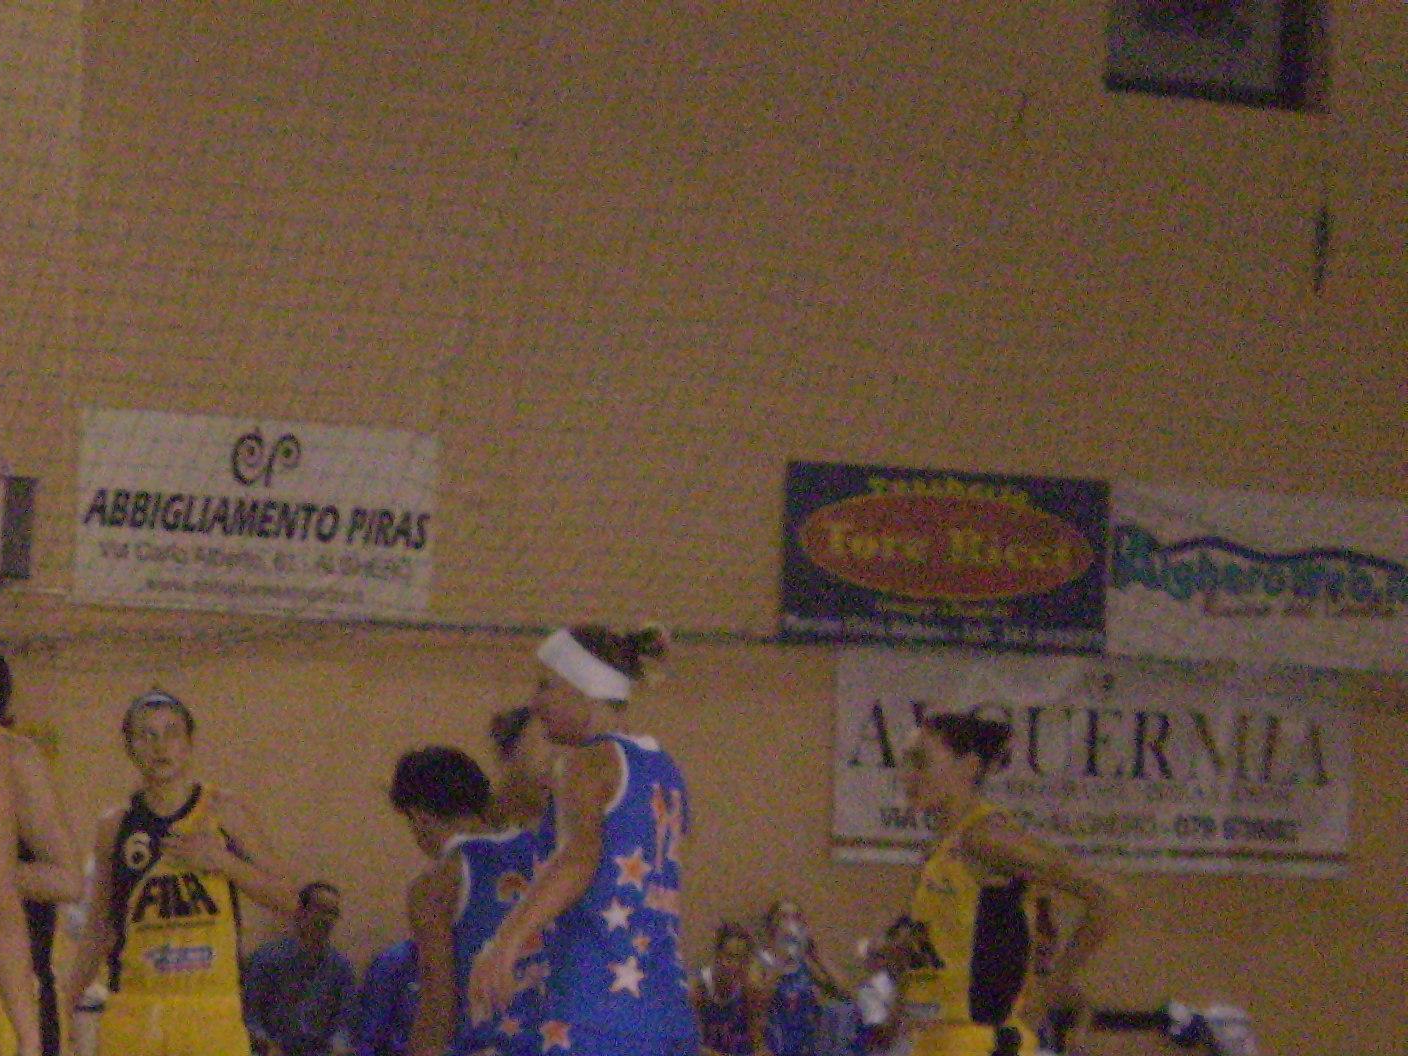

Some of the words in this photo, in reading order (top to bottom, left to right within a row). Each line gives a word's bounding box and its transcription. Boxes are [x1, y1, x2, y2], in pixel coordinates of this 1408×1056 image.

[81, 488, 342, 544] ABBIGLIAMENTO
[345, 506, 433, 551] PIRAS
[848, 699, 1332, 788] AUERMIA
[126, 833, 150, 868] 6
